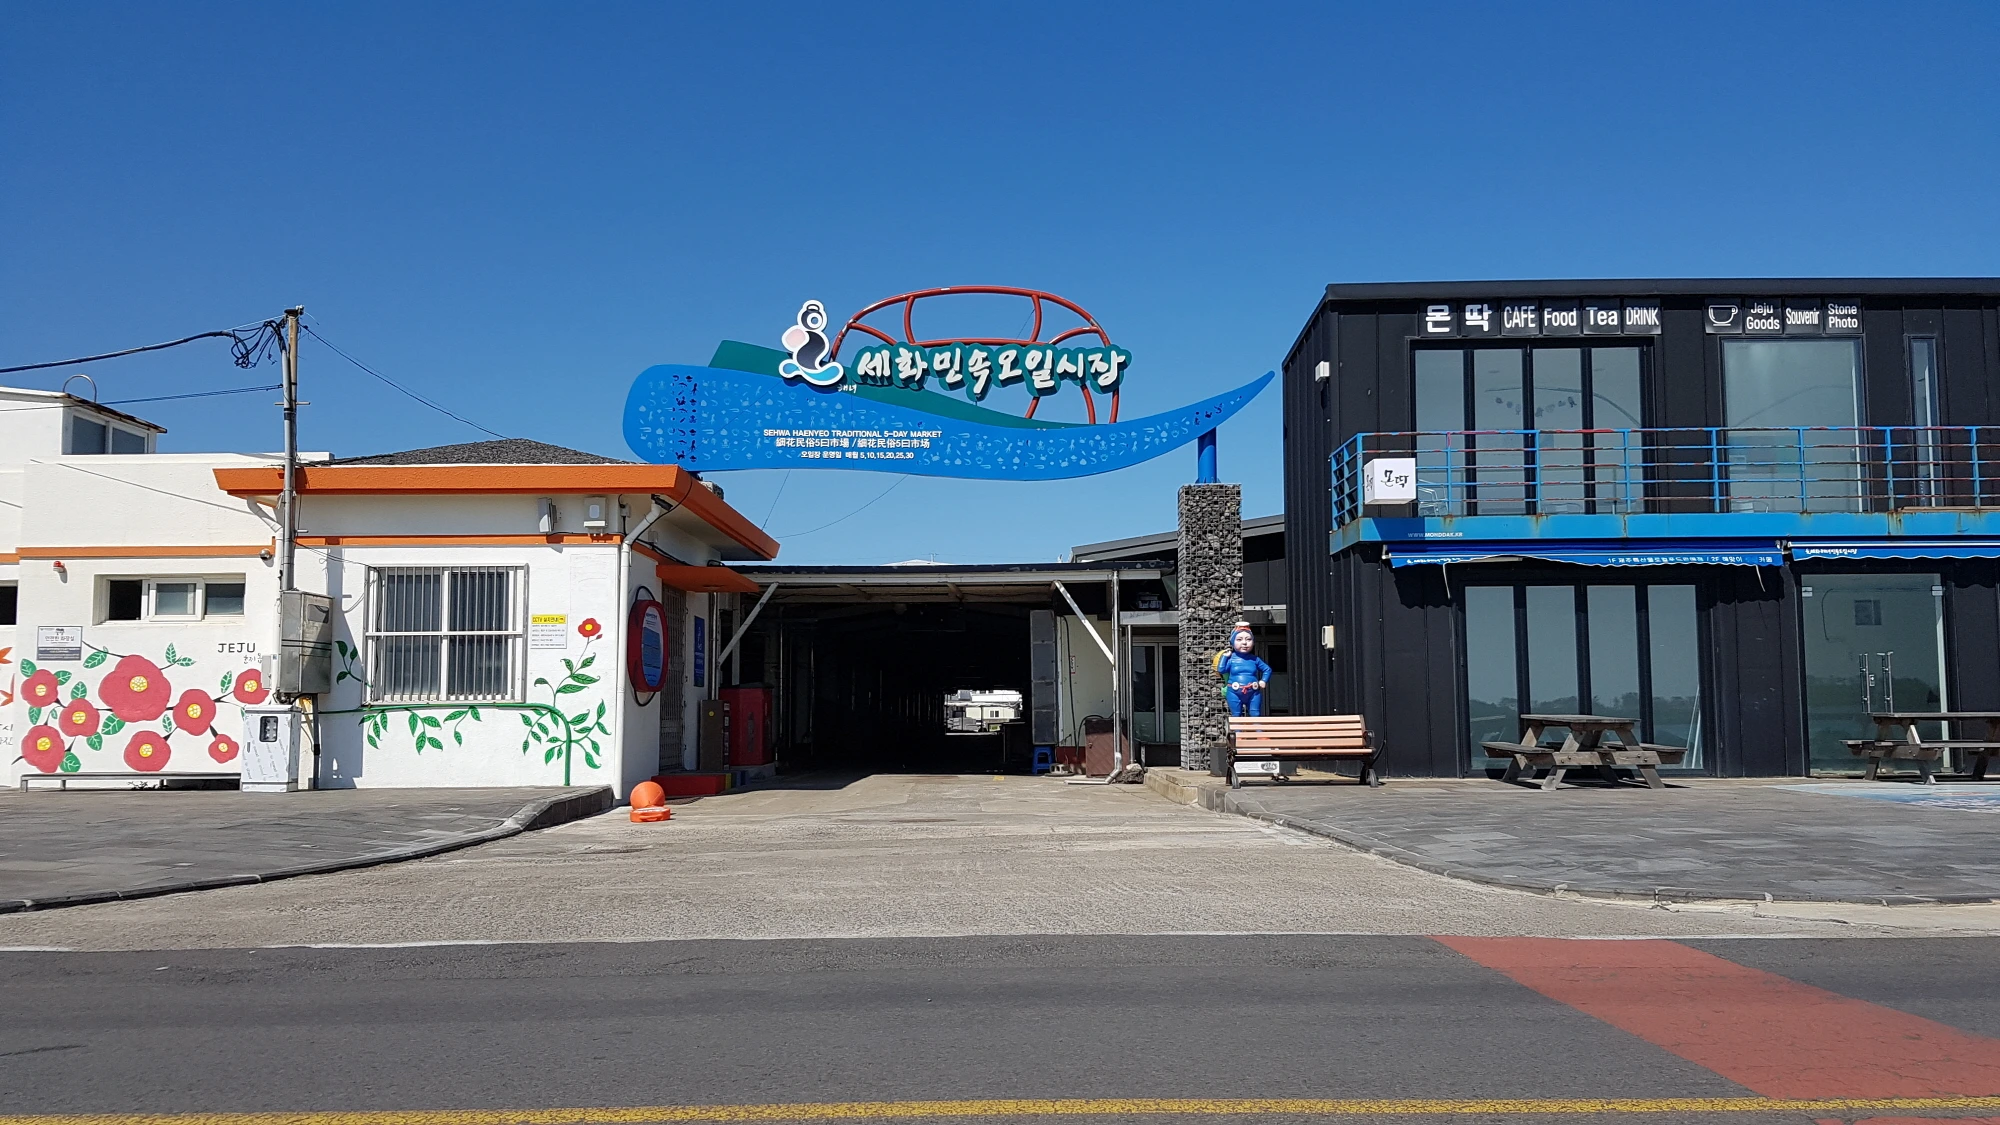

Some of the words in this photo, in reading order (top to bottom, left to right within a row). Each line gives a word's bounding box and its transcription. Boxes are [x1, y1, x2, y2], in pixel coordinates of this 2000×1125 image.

[1751, 303, 1773, 316] Jeju
[1827, 303, 1858, 315] Stone
[1504, 306, 1535, 328] CAFE
[1544, 308, 1577, 326] Food
[1585, 306, 1618, 326] Tea
[1625, 306, 1660, 326] DRINK
[1786, 308, 1819, 324] Souvenir
[1828, 316, 1859, 328] Photo
[1746, 317, 1780, 329] Goods
[857, 348, 1125, 394] 세화민속오일시장
[763, 429, 791, 437] SEHWA
[831, 430, 882, 438] TRADITIONAL
[217, 643, 255, 653] JEJU
